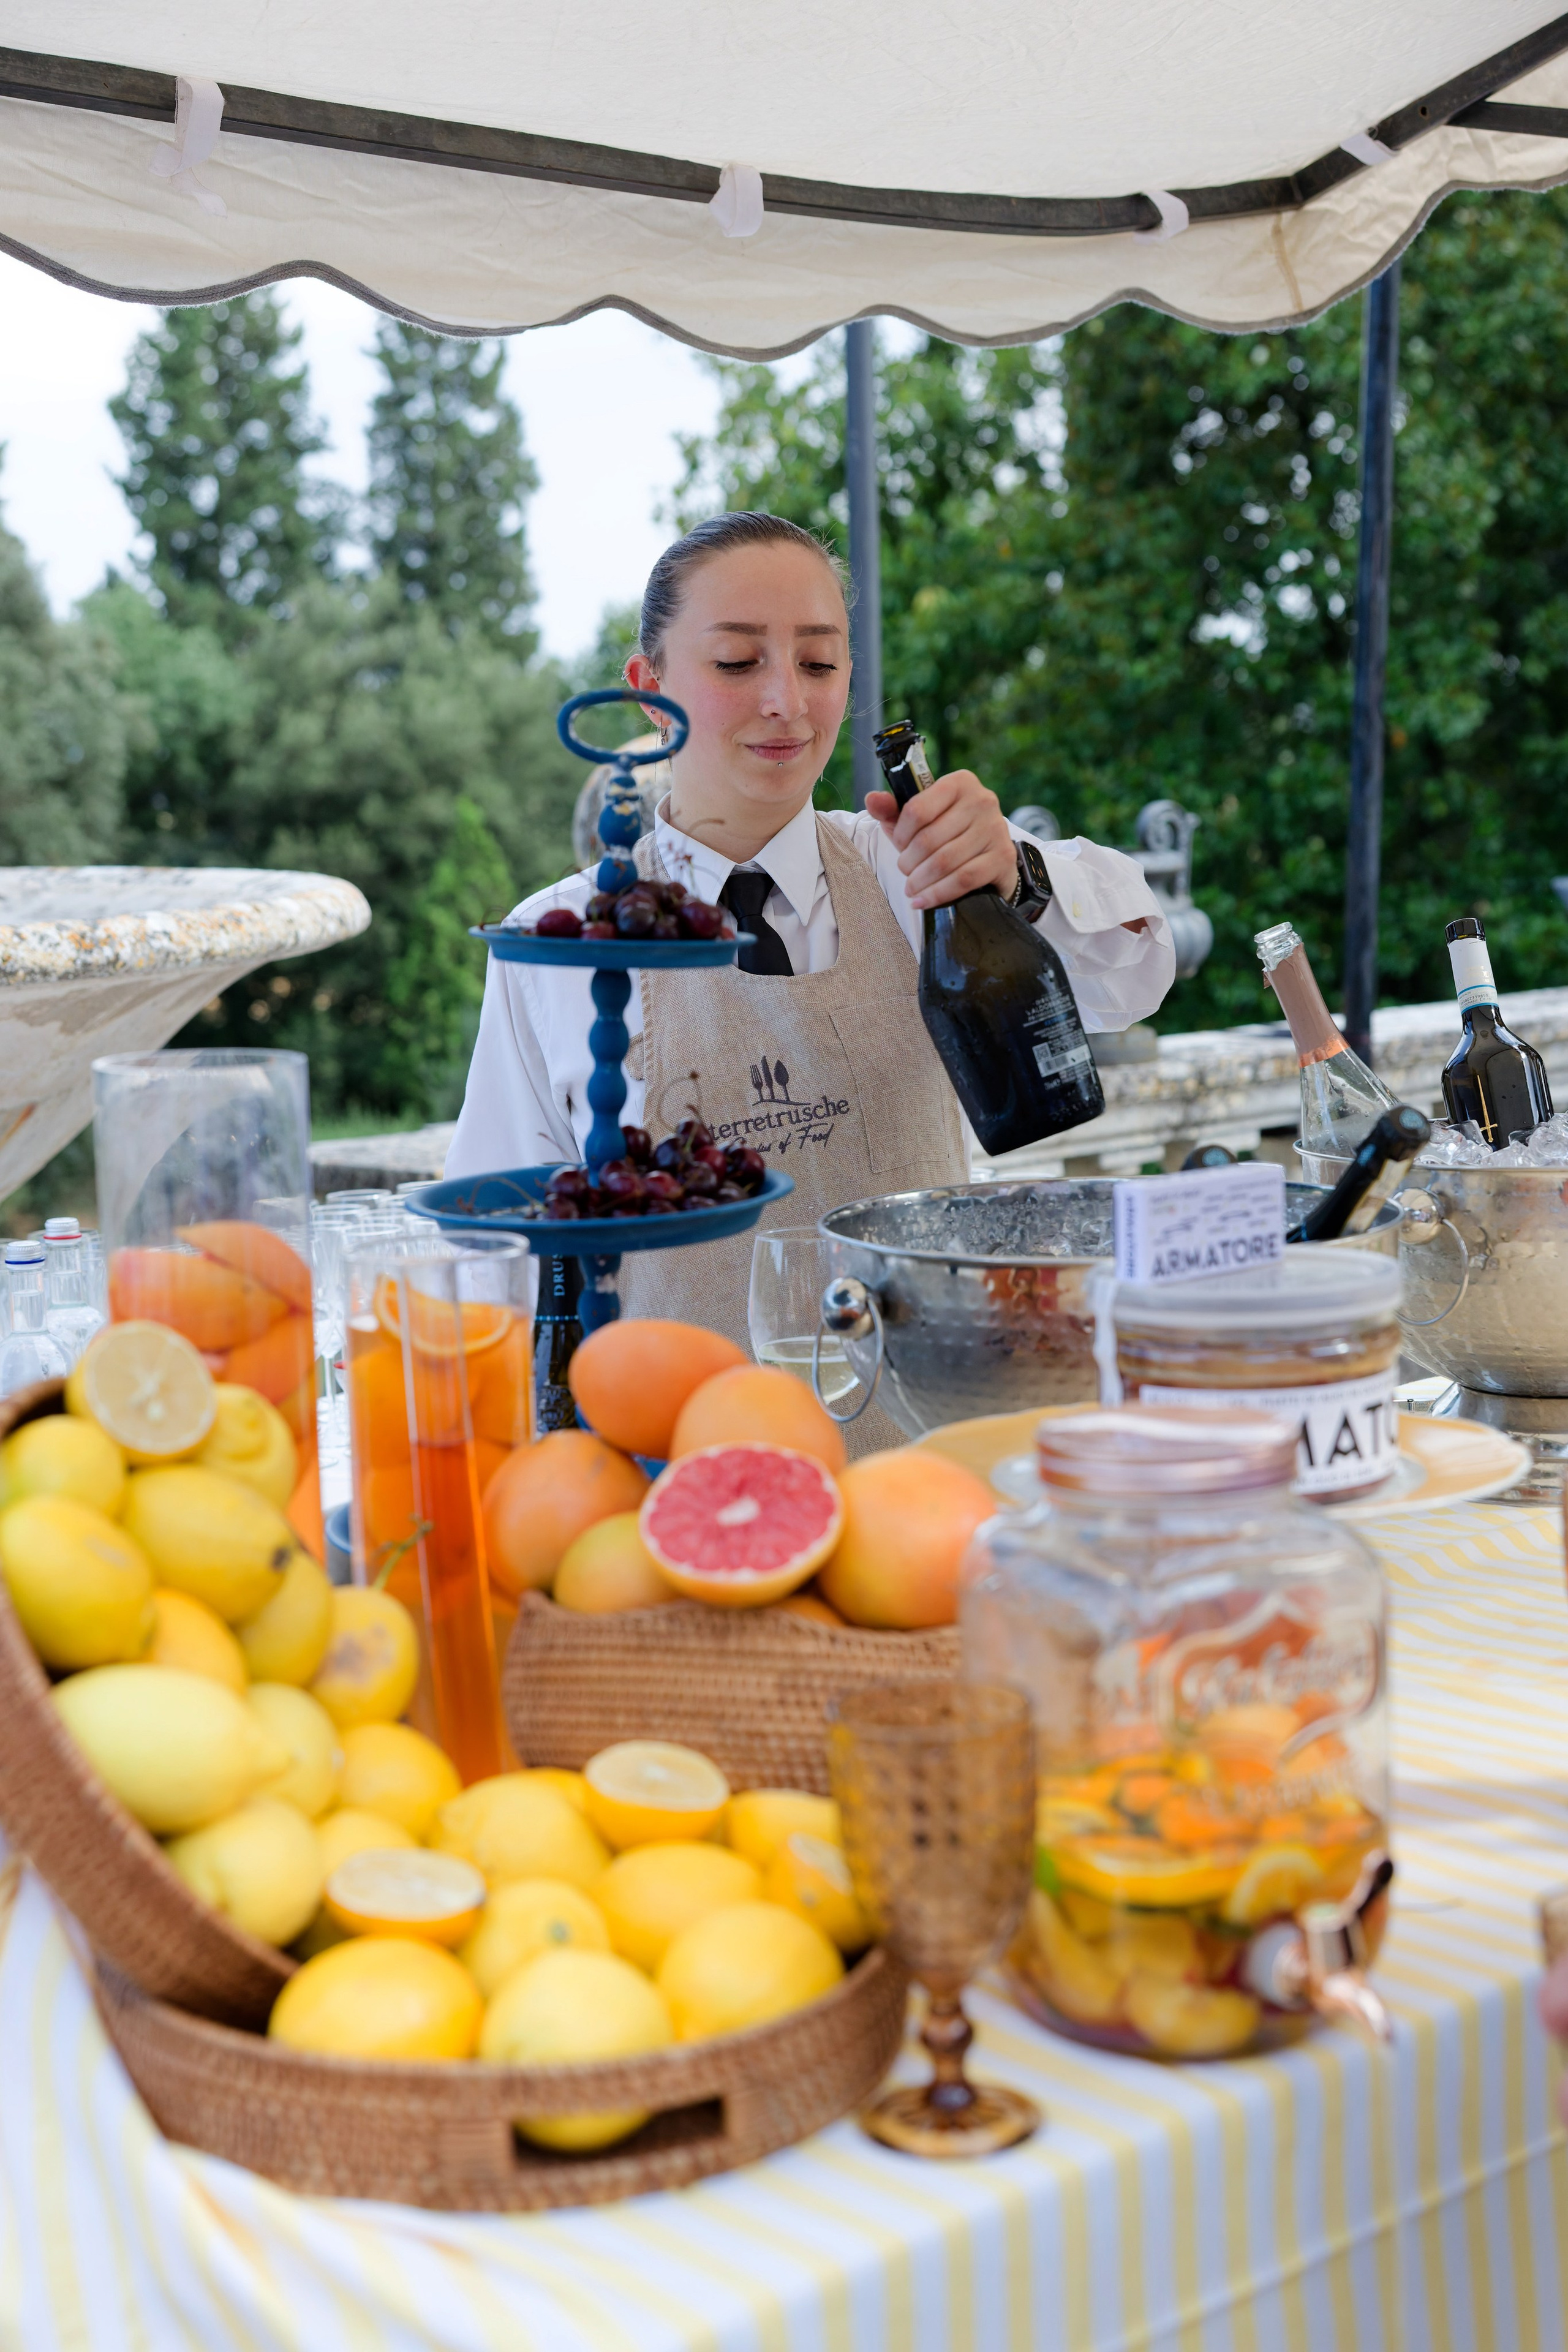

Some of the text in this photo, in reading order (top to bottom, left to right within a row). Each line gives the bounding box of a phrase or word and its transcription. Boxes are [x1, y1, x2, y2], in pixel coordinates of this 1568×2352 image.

[707, 1095, 850, 1140] terretrusche
[778, 1133, 791, 1154] of
[797, 1123, 834, 1150] Food
[1151, 1232, 1279, 1277] ARMATORE
